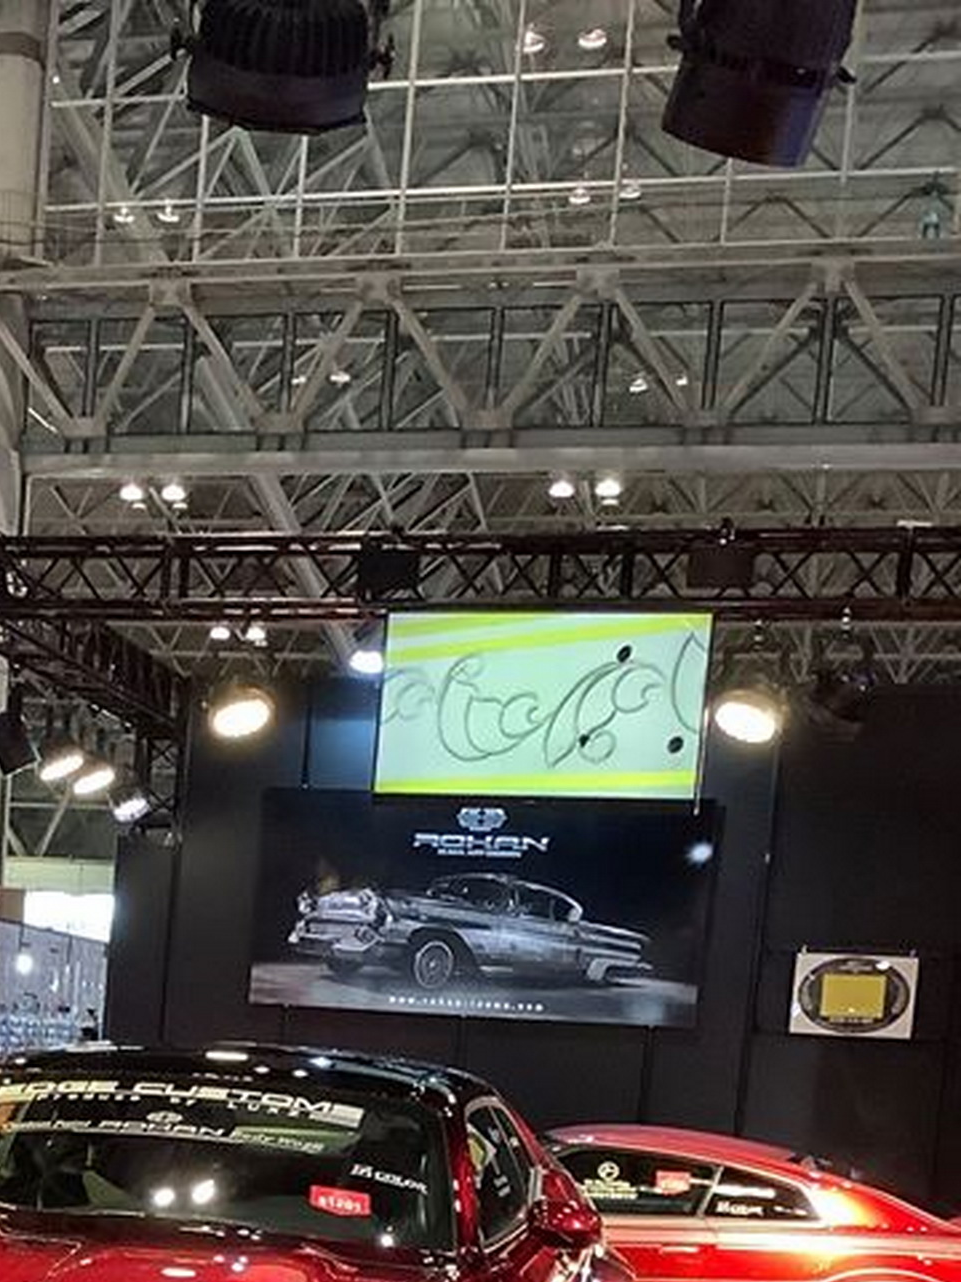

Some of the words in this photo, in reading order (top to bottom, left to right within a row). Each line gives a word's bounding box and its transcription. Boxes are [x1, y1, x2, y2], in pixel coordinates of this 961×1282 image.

[412, 832, 550, 853] ROHAN
[133, 1082, 365, 1129] CUSTOMS
[97, 1120, 225, 1140] ROHAN
